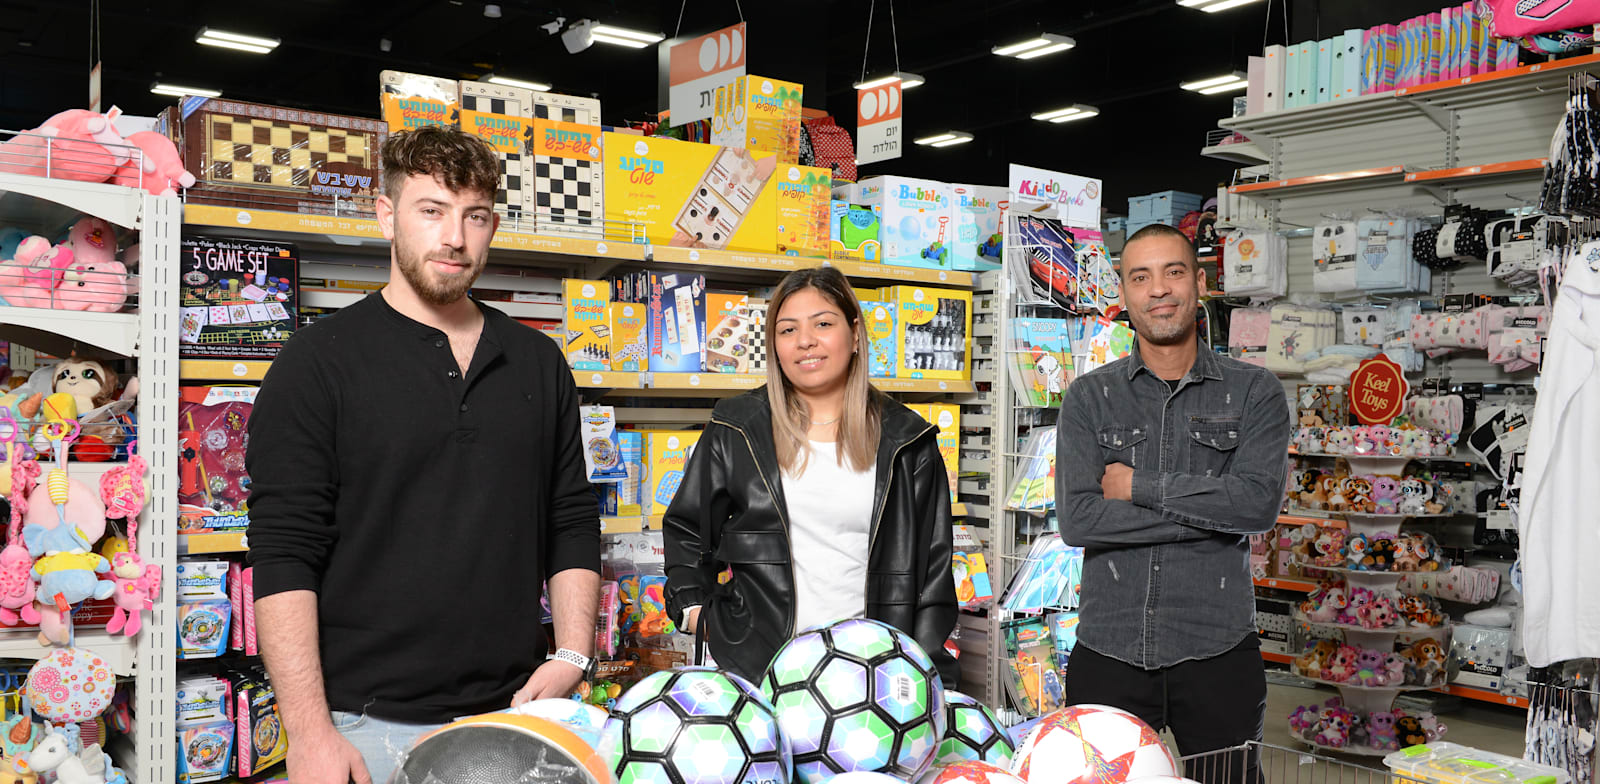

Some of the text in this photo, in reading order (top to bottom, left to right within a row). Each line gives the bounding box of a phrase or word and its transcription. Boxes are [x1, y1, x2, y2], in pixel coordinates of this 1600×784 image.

[886, 126, 898, 136] יום
[872, 140, 897, 154] הולדת
[619, 156, 664, 174] סלינג
[317, 171, 372, 188] שש-בש
[630, 168, 655, 185] שוט
[900, 184, 940, 202] Bubble
[960, 195, 989, 208] Bubble
[193, 248, 269, 276] 5 GAME SET
[903, 302, 934, 312] שח-מט
[1032, 321, 1057, 332] SNOOPY
[1362, 371, 1392, 393] Keel
[1360, 388, 1389, 412] Toys
[231, 577, 242, 643] SUPERKING
[244, 584, 255, 649] SUPERKING
[240, 707, 249, 770] SUPERKING
